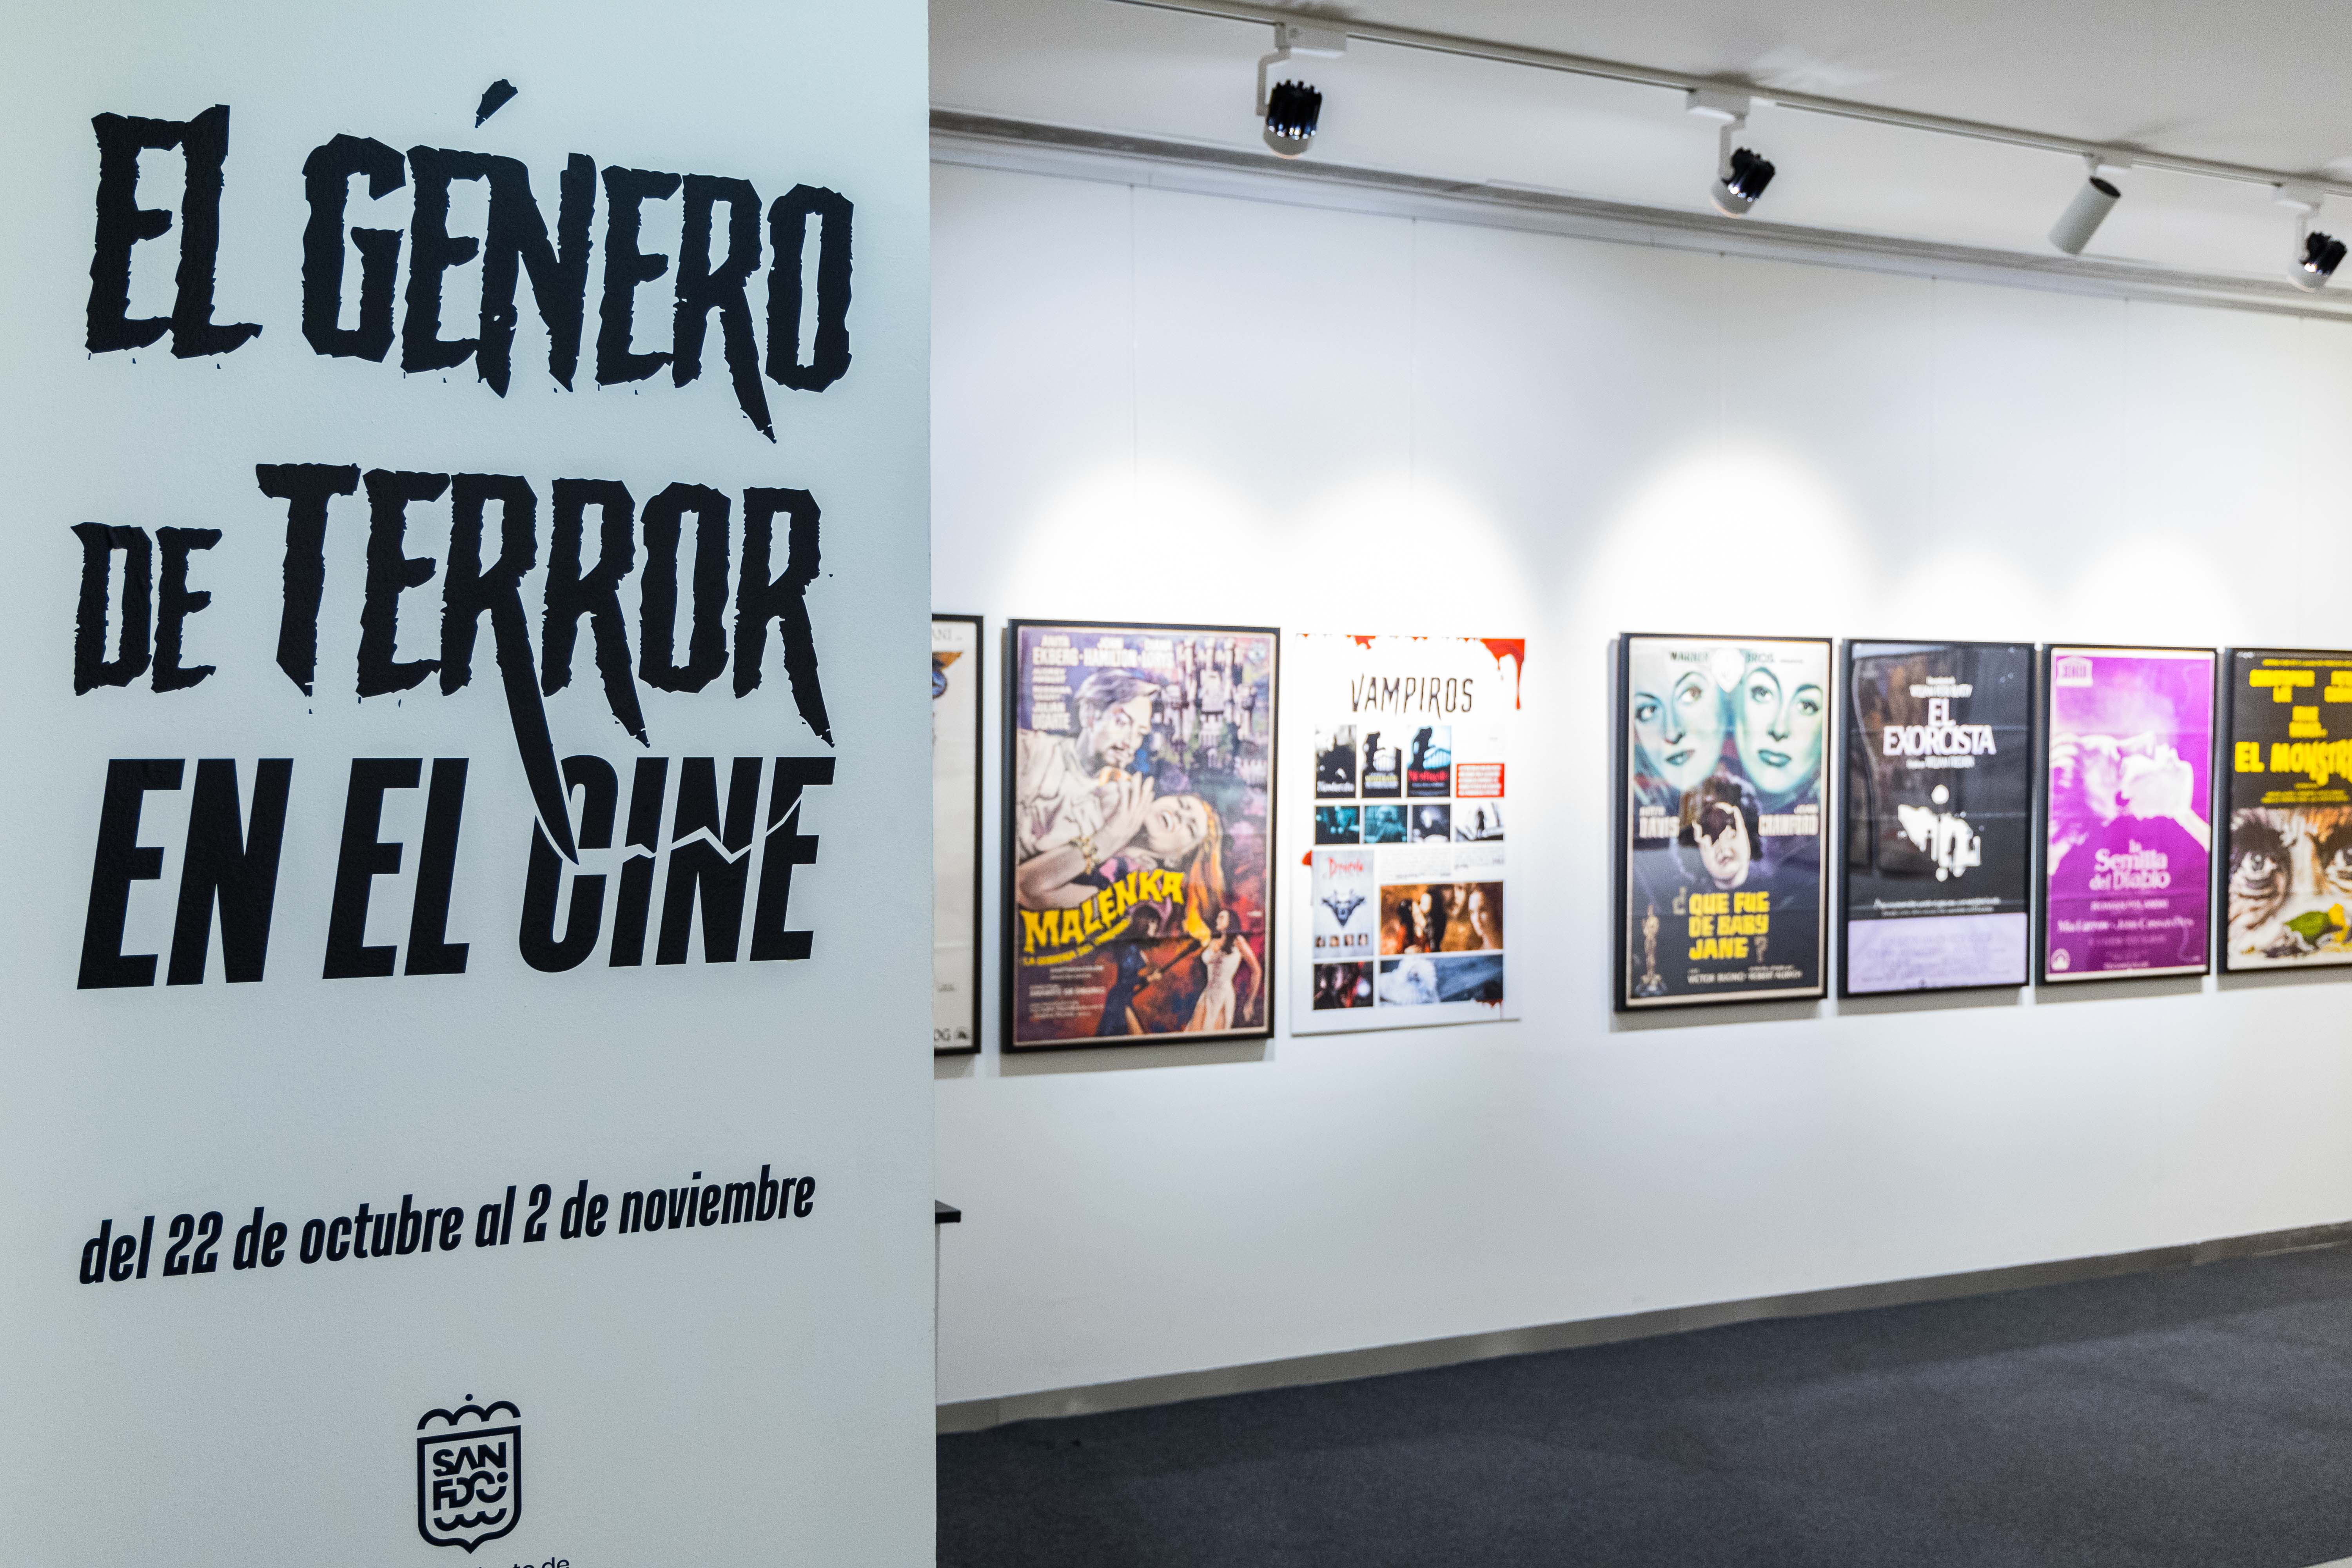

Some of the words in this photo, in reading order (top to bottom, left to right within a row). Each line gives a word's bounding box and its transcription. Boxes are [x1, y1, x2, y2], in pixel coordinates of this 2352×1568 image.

[85, 104, 263, 361] EL
[301, 78, 854, 444] GÉNERO
[71, 522, 222, 696] DE
[256, 463, 835, 865] TERROR
[1351, 673, 1474, 720] VAMPIROS
[1928, 699, 1956, 726] EL
[1883, 725, 1997, 755] EXORCISTA
[2235, 741, 2265, 772] EL
[1639, 816, 1680, 838] DAVIS
[1759, 814, 1818, 836] CRAWFORD
[77, 759, 294, 989] EN
[323, 758, 469, 976] EL
[519, 755, 836, 973] CINE
[1020, 869, 1185, 953] MALENKA
[1689, 916, 1713, 937] DE
[1717, 914, 1769, 936] BABY
[80, 1216, 155, 1284] del
[163, 1211, 223, 1276] 22
[233, 1207, 287, 1270] de
[300, 1194, 464, 1264] octubre
[475, 1185, 516, 1247] al
[523, 1184, 551, 1243] 2
[561, 1180, 608, 1240] de
[619, 1164, 815, 1234] noviembre
[433, 1442, 506, 1477] SAN
[542, 1557, 570, 1568] de
